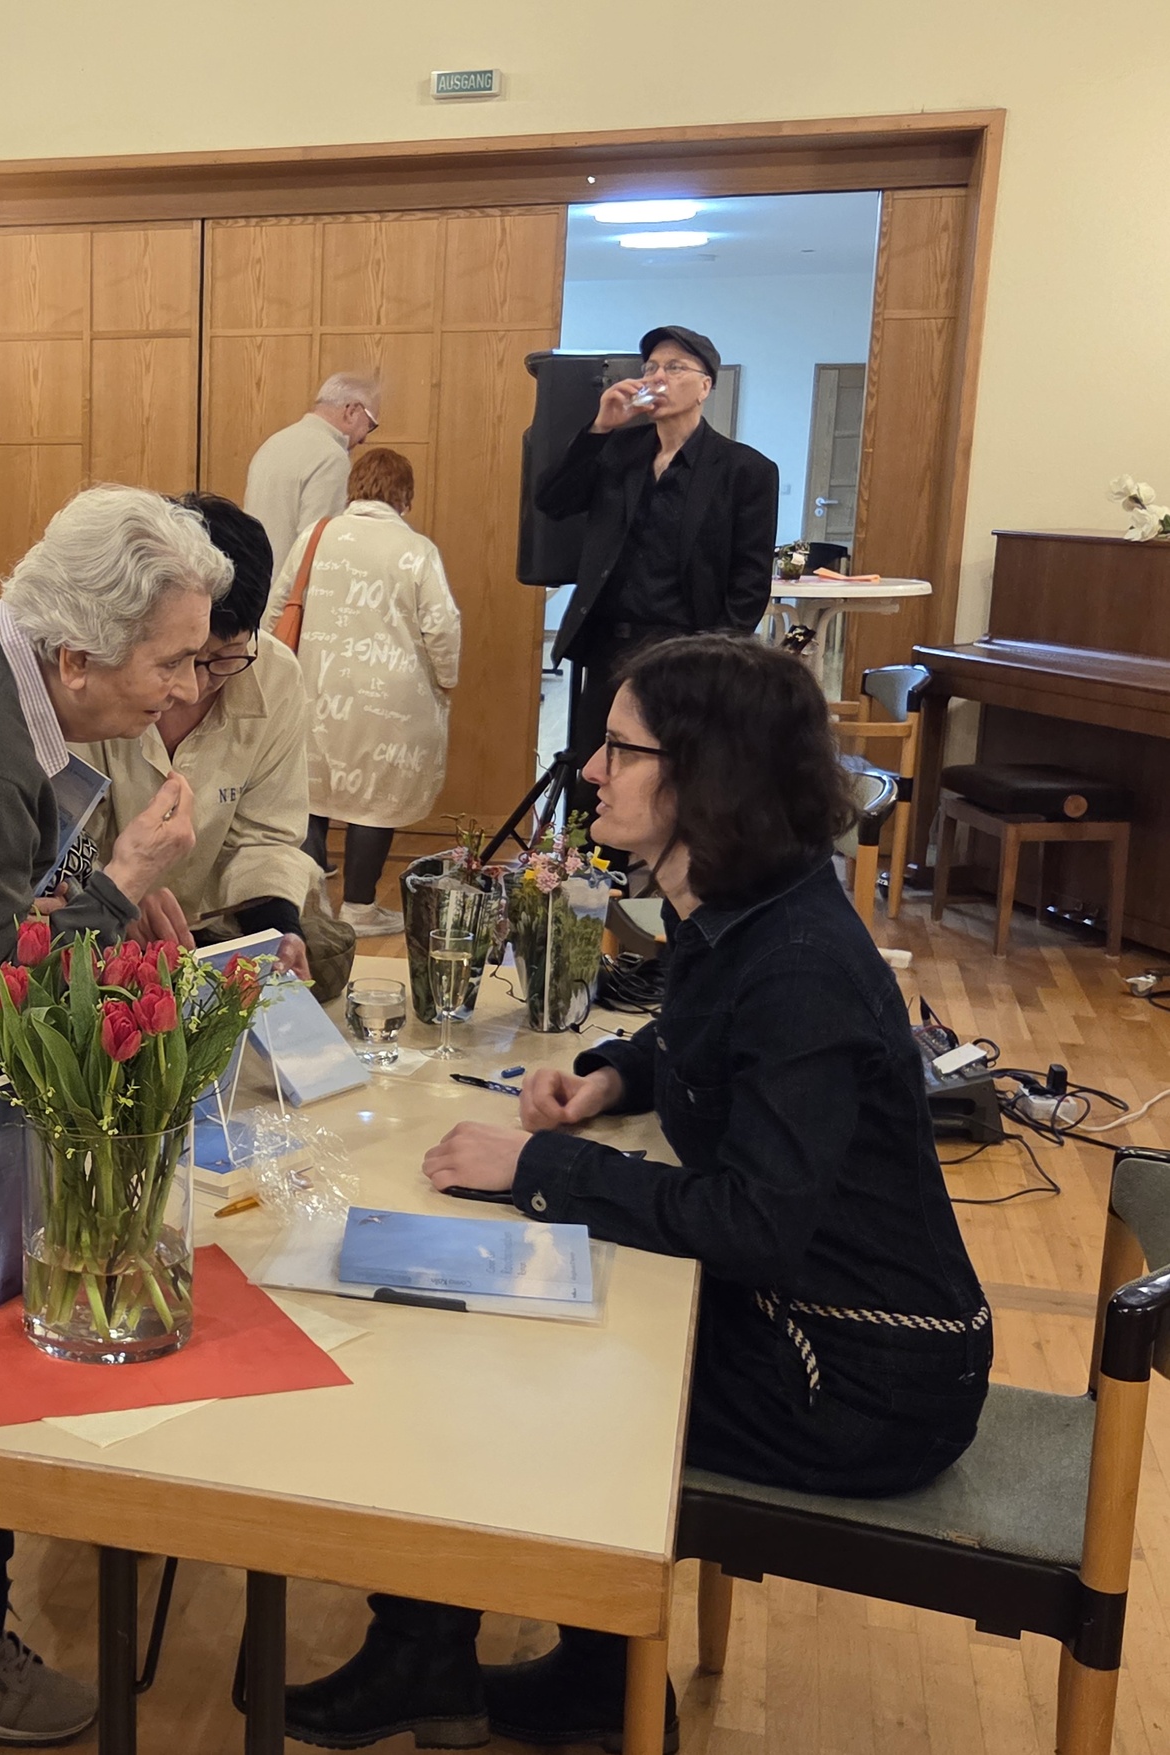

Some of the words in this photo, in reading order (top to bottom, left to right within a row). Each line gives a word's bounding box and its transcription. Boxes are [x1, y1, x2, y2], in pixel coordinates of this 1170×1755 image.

[438, 73, 492, 91] AUSGANG
[341, 637, 418, 674] CHANGE
[219, 786, 242, 803] NE
